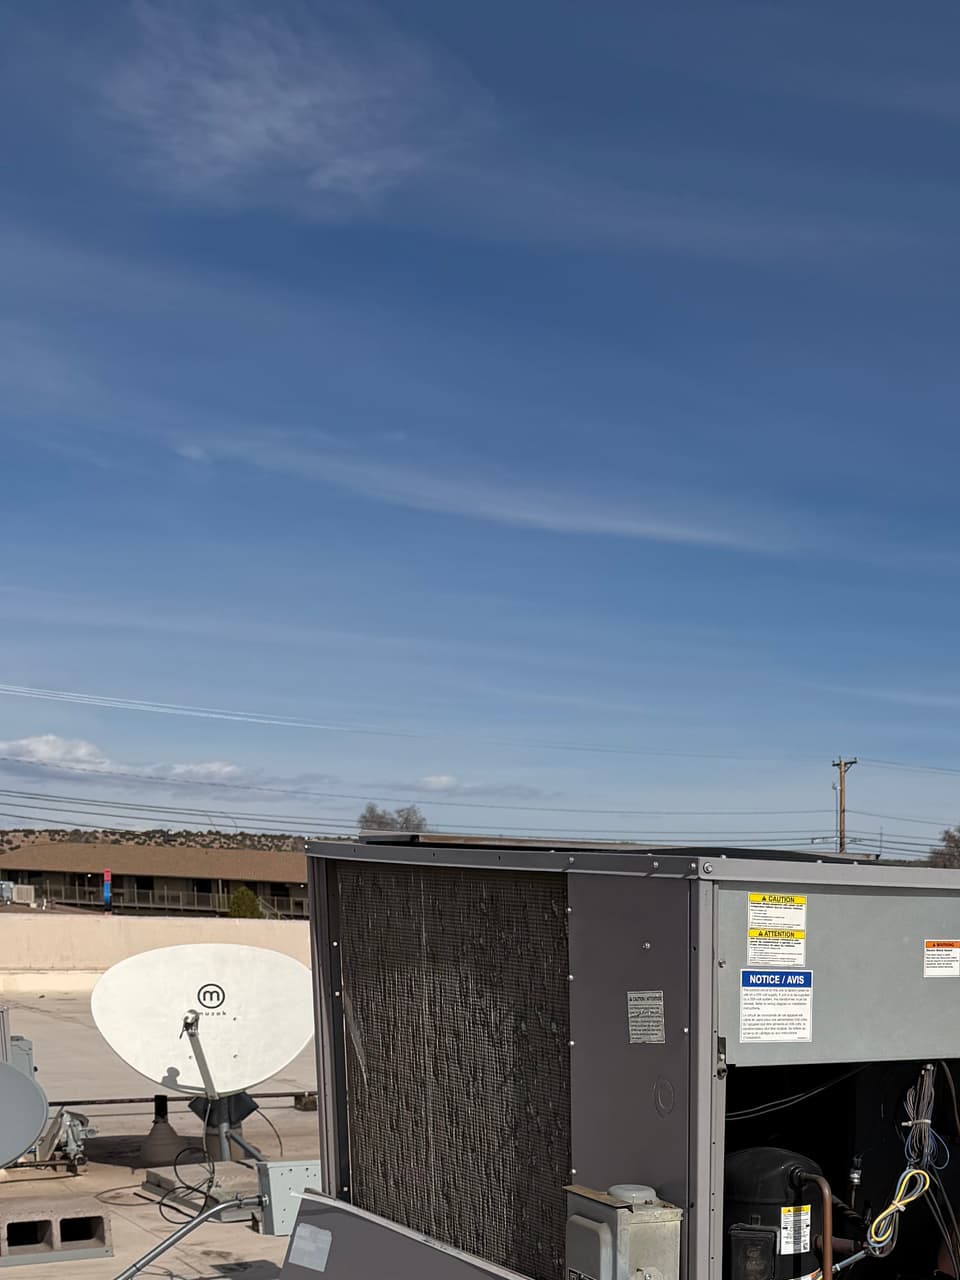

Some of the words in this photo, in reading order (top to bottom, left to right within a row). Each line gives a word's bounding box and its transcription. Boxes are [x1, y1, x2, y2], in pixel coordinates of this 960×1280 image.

[768, 895, 795, 903] CAUTION
[764, 930, 795, 938] ATTENTION
[750, 974, 780, 984] NOTICE
[786, 975, 805, 984] AVIS
